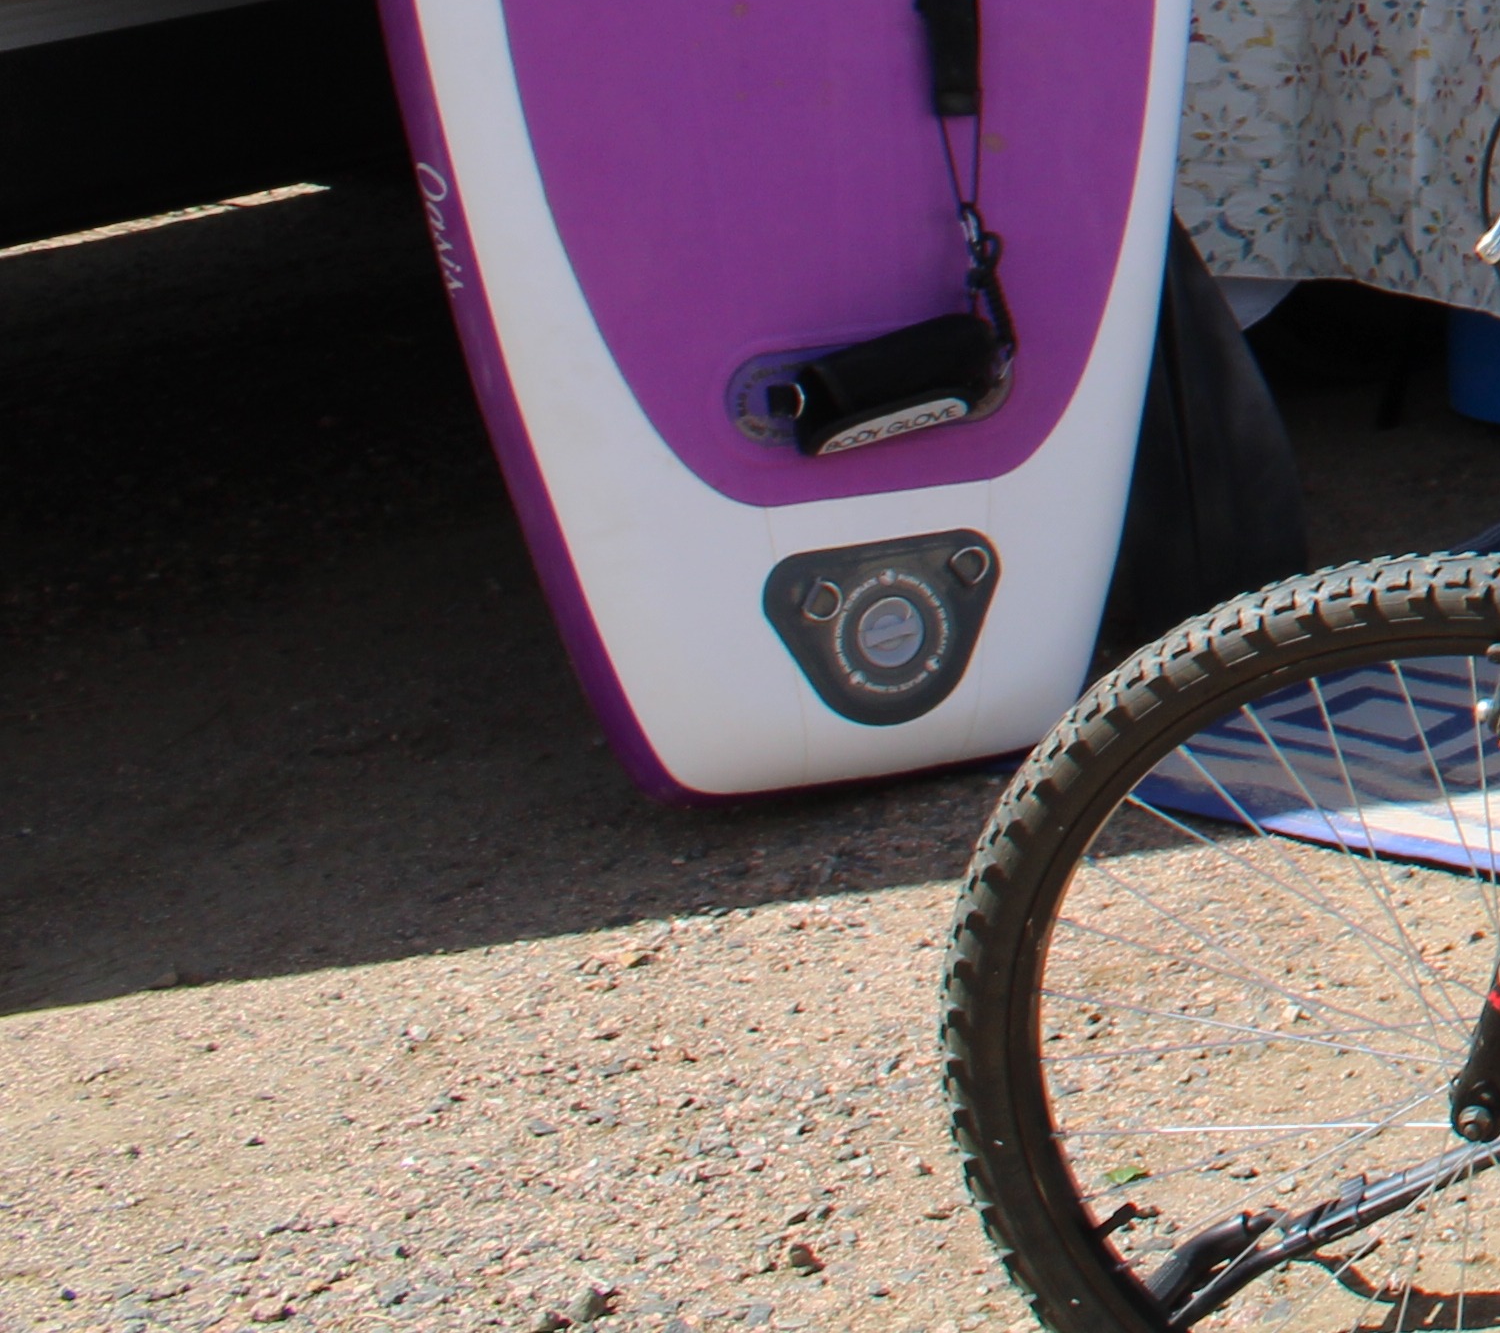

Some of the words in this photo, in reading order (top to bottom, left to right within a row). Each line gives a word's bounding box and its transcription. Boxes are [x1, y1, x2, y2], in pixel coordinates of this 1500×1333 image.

[415, 161, 465, 299] Oasis
[824, 426, 883, 452] BODY
[886, 404, 957, 434] GLOVE
